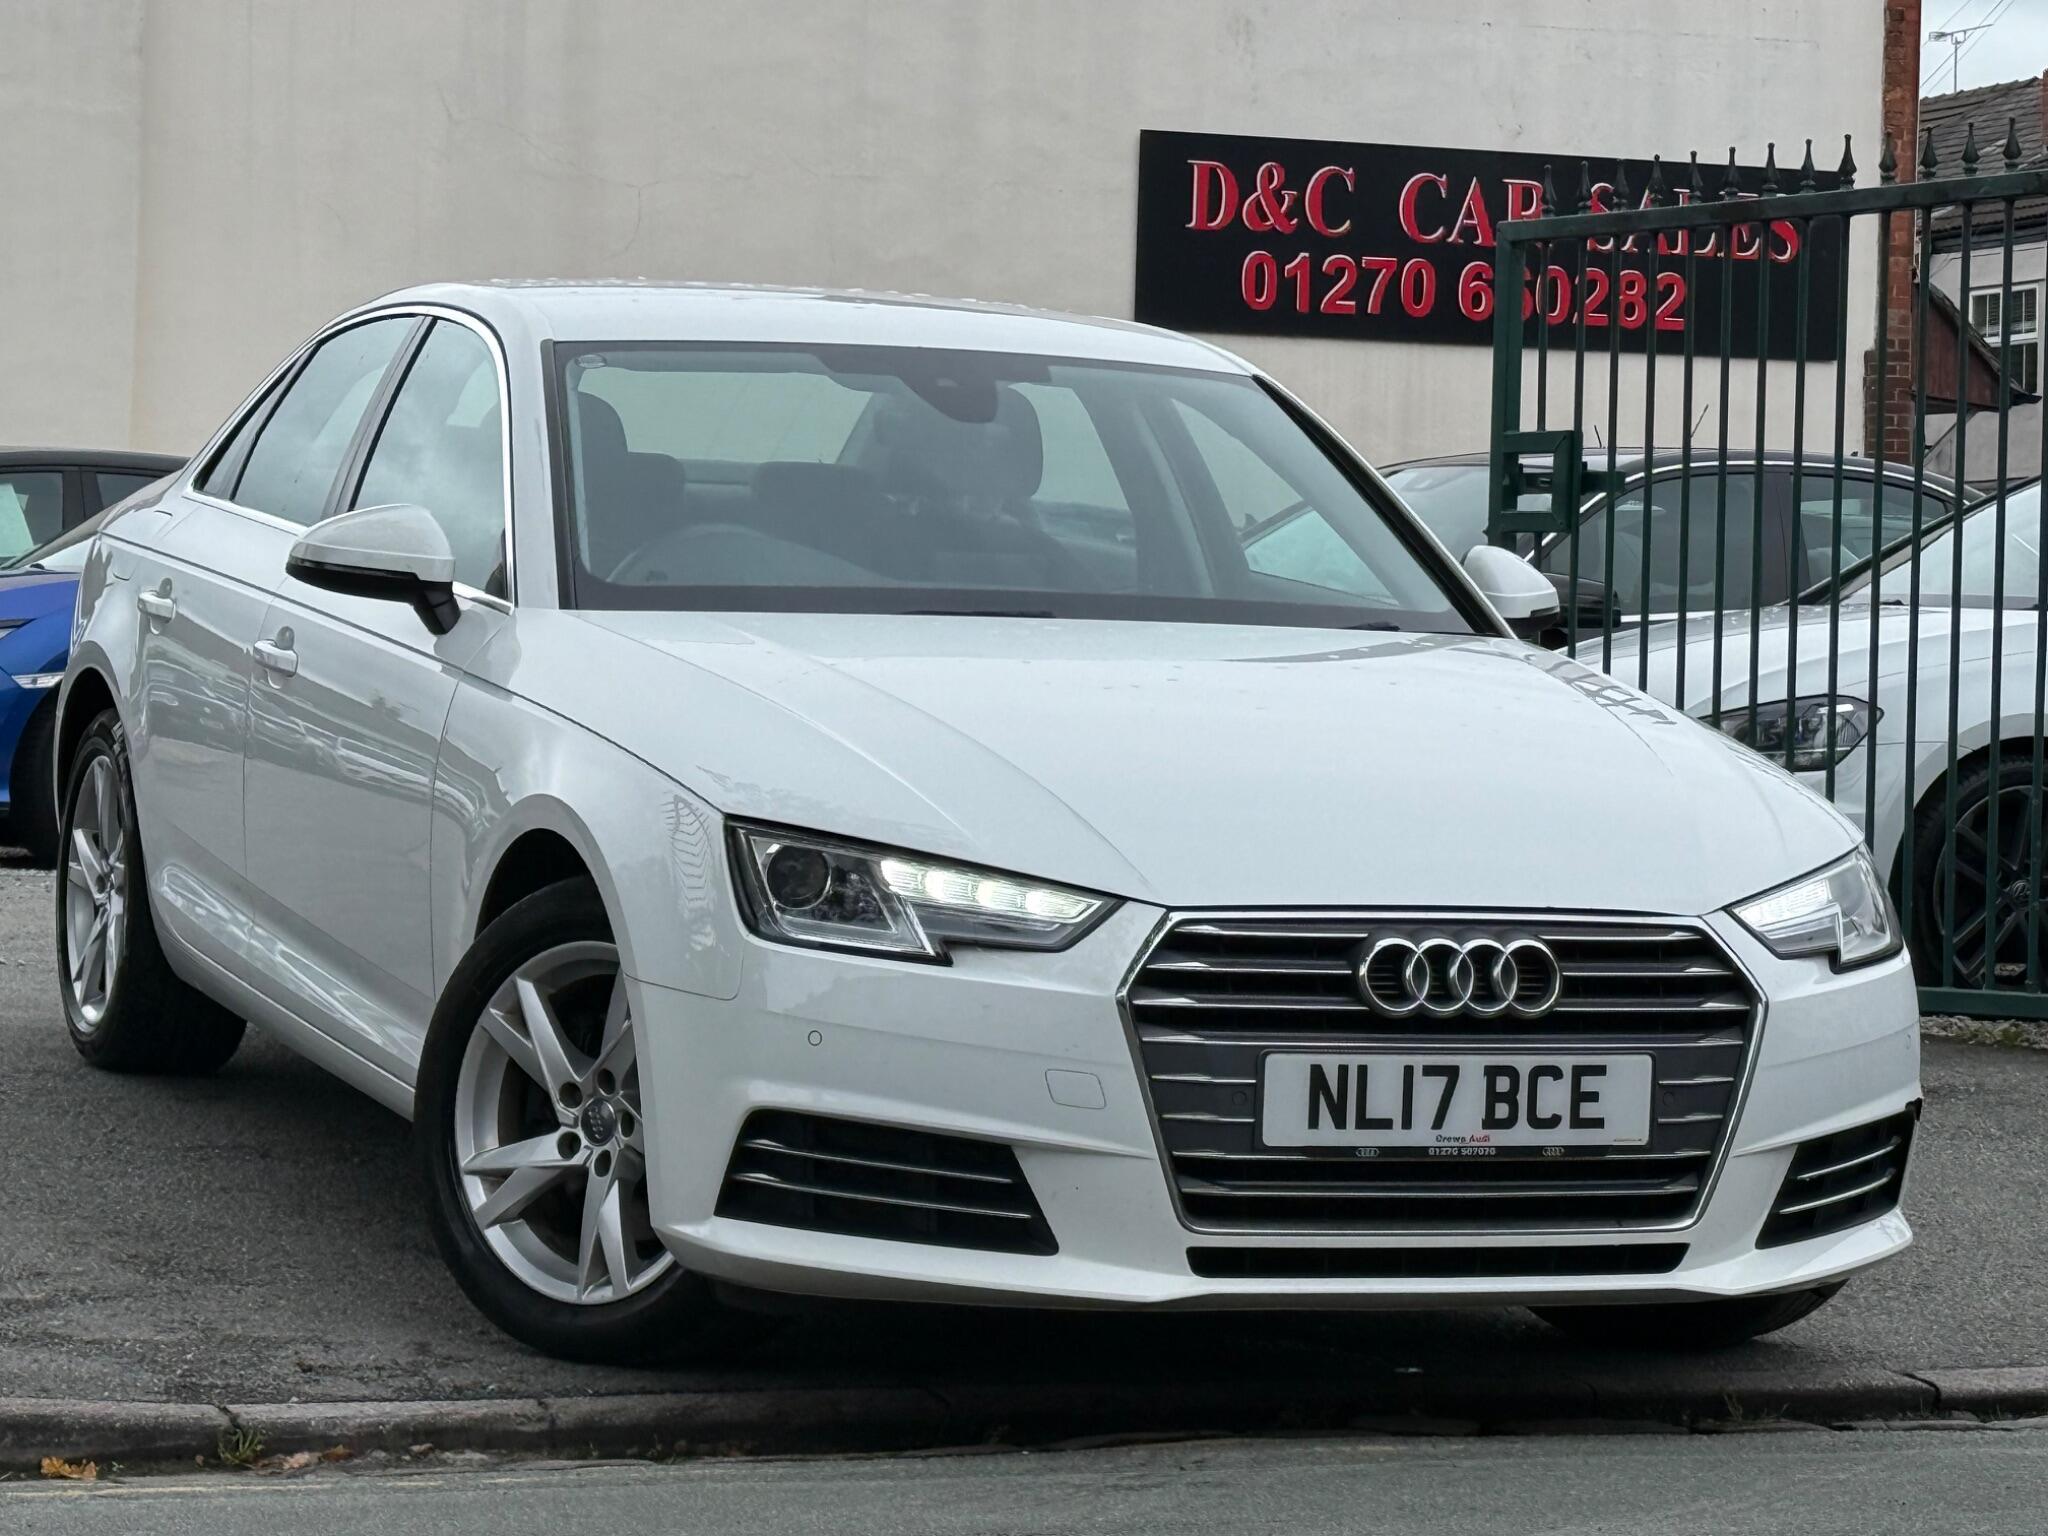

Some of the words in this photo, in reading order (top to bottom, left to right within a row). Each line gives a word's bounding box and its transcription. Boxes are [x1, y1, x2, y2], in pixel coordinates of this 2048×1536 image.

[1184, 159, 1356, 237] D&C
[1241, 250, 1436, 318] 01270
[1307, 1063, 1460, 1131] NL17
[1481, 1064, 1607, 1131] BCE
[1428, 1147, 1459, 1156] 01270
